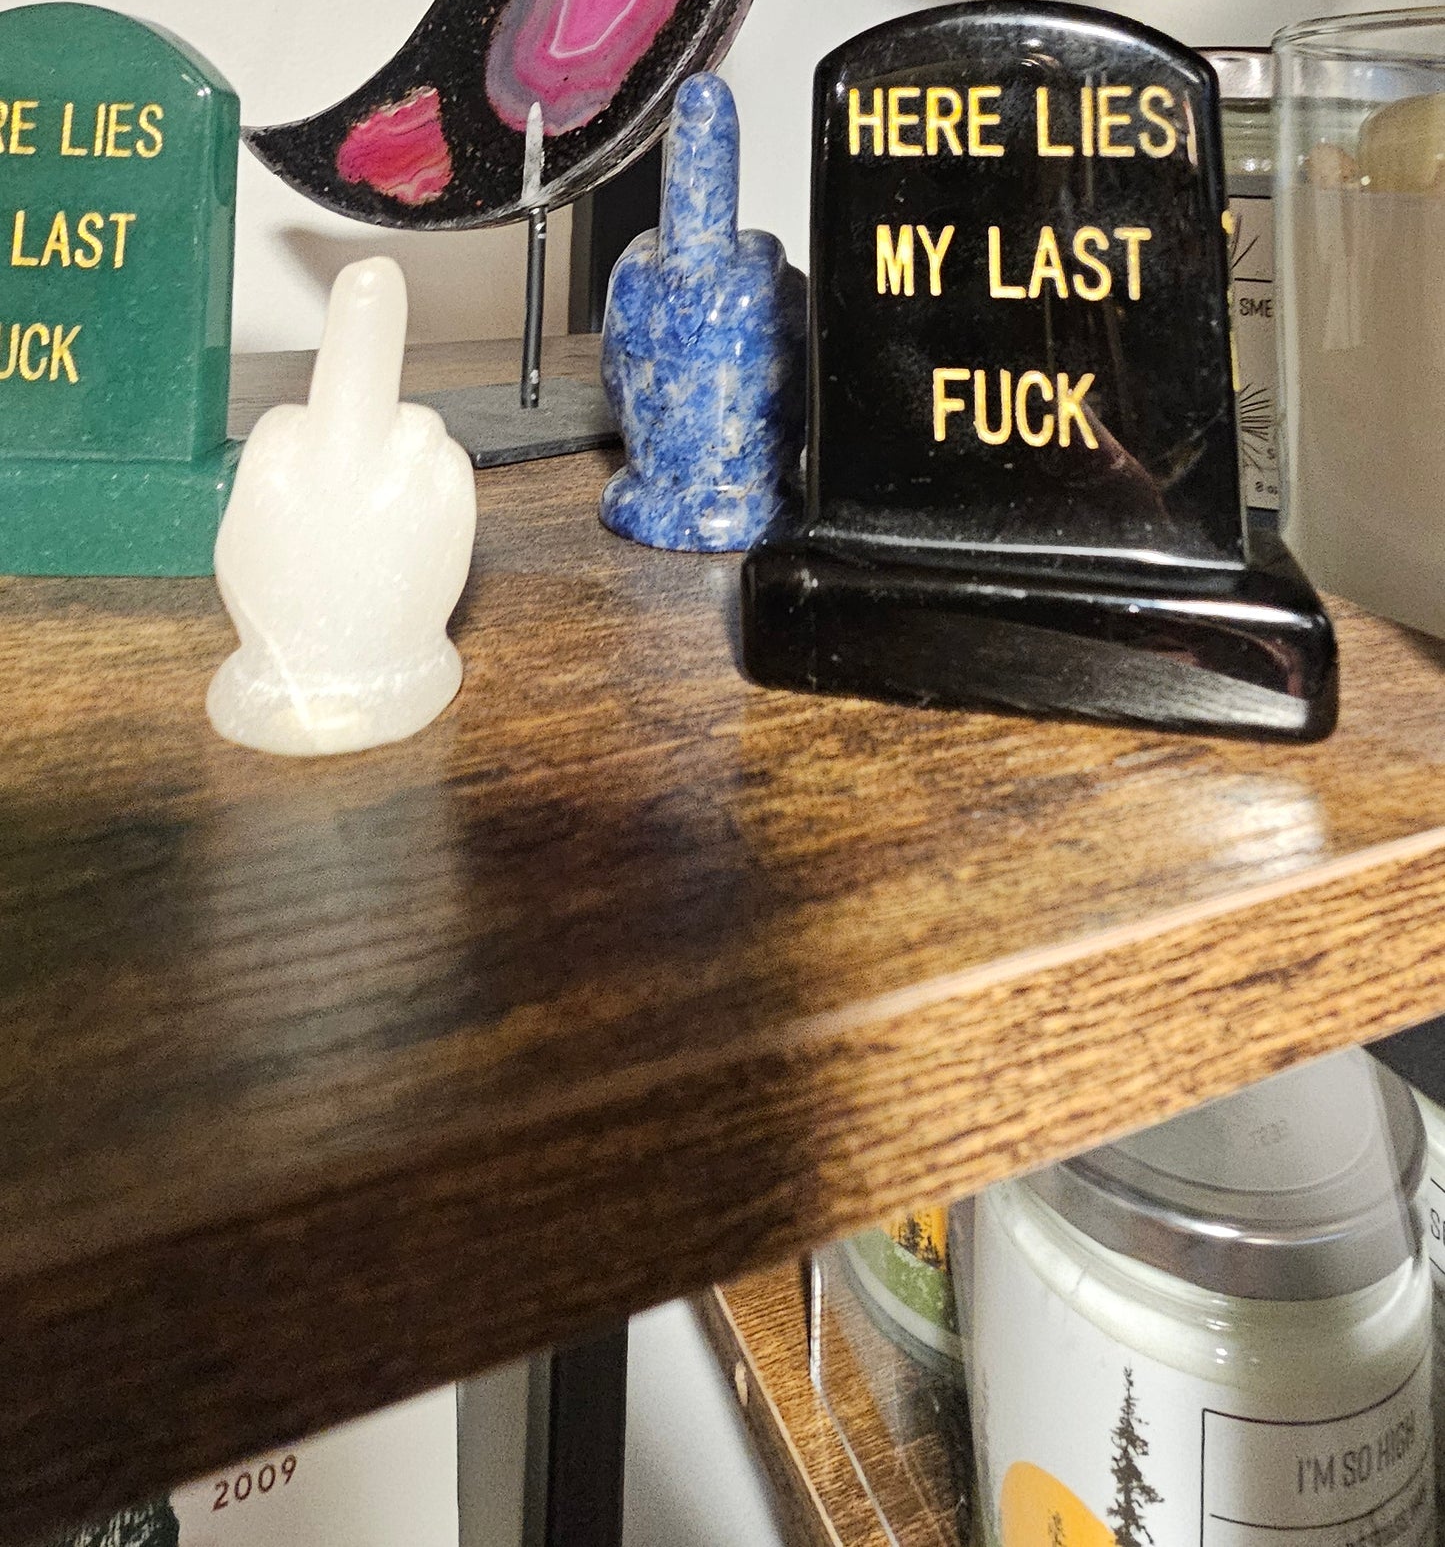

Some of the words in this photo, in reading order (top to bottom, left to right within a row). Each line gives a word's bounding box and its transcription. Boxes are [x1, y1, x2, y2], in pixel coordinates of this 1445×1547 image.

[0, 101, 40, 157] E
[60, 102, 165, 159] LIES
[847, 85, 1005, 158] HERE
[1036, 85, 1178, 159] LIES
[10, 209, 137, 270] LAST
[876, 224, 955, 297] MY
[987, 225, 1152, 302] LAST
[932, 367, 1100, 451] FUCK
[210, 1454, 297, 1513] 2009
[1297, 1454, 1335, 1494] I'M
[1342, 1444, 1373, 1487] SO
